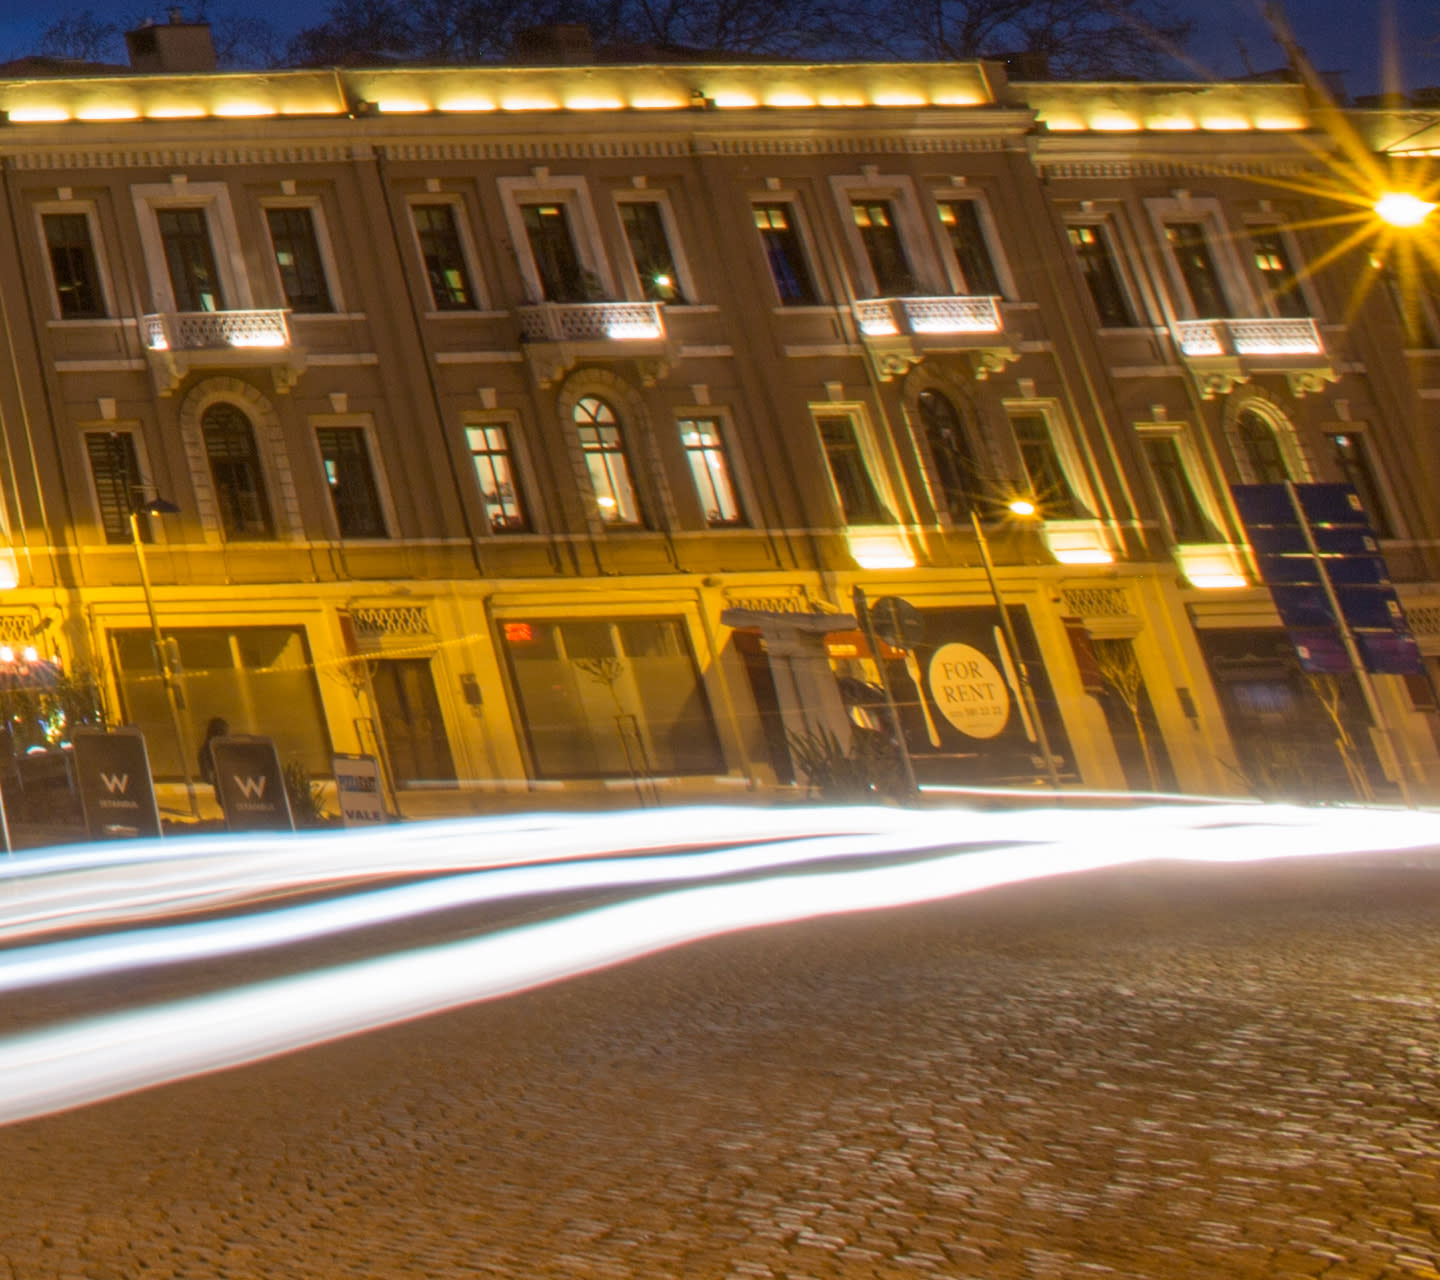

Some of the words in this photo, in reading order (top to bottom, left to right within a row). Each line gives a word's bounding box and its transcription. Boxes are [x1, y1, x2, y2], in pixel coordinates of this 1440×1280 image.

[941, 660, 984, 680] FOR
[942, 683, 996, 703] RENT
[100, 772, 129, 794] W
[233, 775, 267, 799] W
